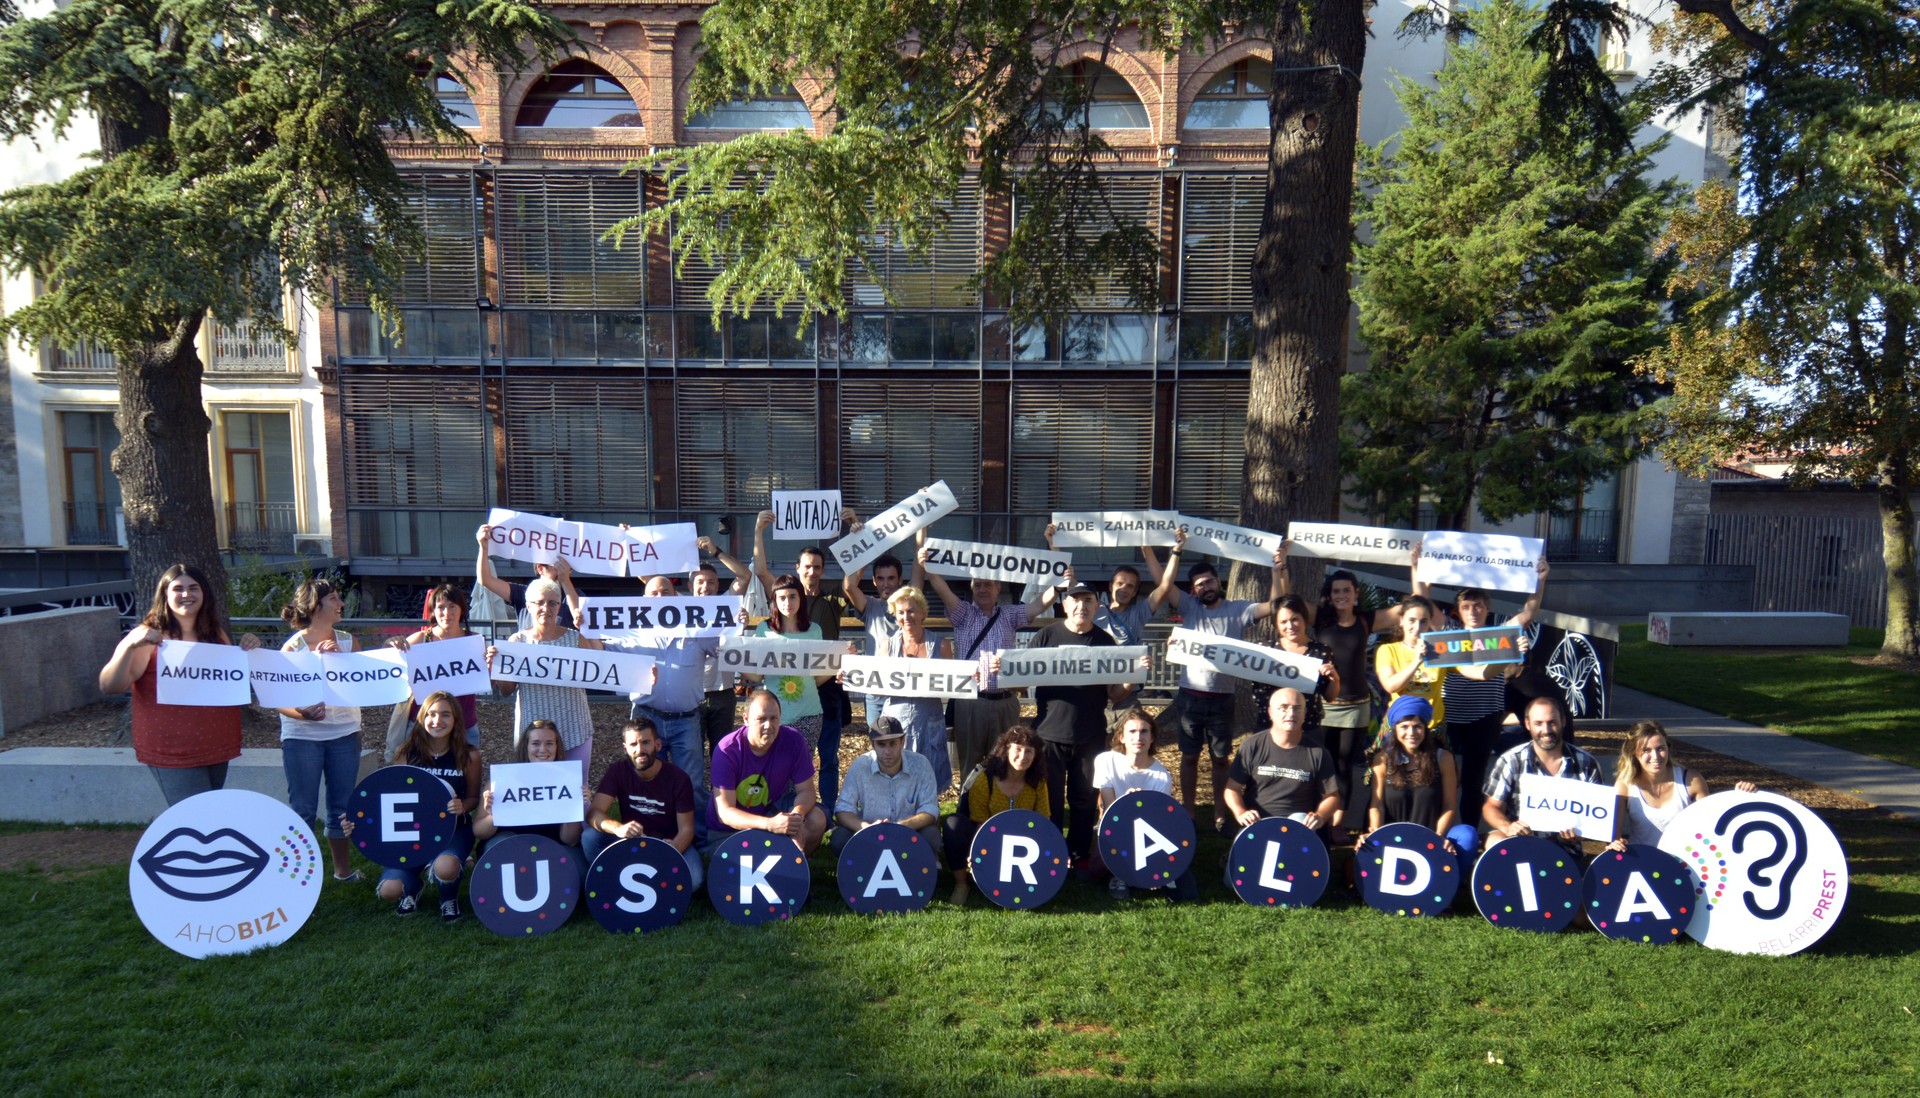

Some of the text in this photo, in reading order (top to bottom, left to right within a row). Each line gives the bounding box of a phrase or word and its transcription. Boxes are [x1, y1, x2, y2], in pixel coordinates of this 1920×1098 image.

[775, 499, 840, 531] LAUTADA
[1056, 520, 1176, 532] ALDE ZAHARRA
[490, 525, 658, 562] GORBEIALDEA
[926, 548, 1067, 577] ZALDUONDO
[1424, 550, 1534, 568] AÑANAKO KUADRILLA
[587, 605, 737, 630] IEKORA
[1434, 636, 1512, 655] DURANA
[161, 665, 244, 681] AMURRIO
[250, 671, 321, 683] ARTZINIEGA
[326, 666, 402, 682] OKONDO
[413, 659, 480, 684] AIARA
[499, 654, 621, 686] BASTIDA
[502, 785, 572, 803] ARETA
[1526, 795, 1608, 820] LAUDIO
[175, 907, 288, 943] AHOBIZI
